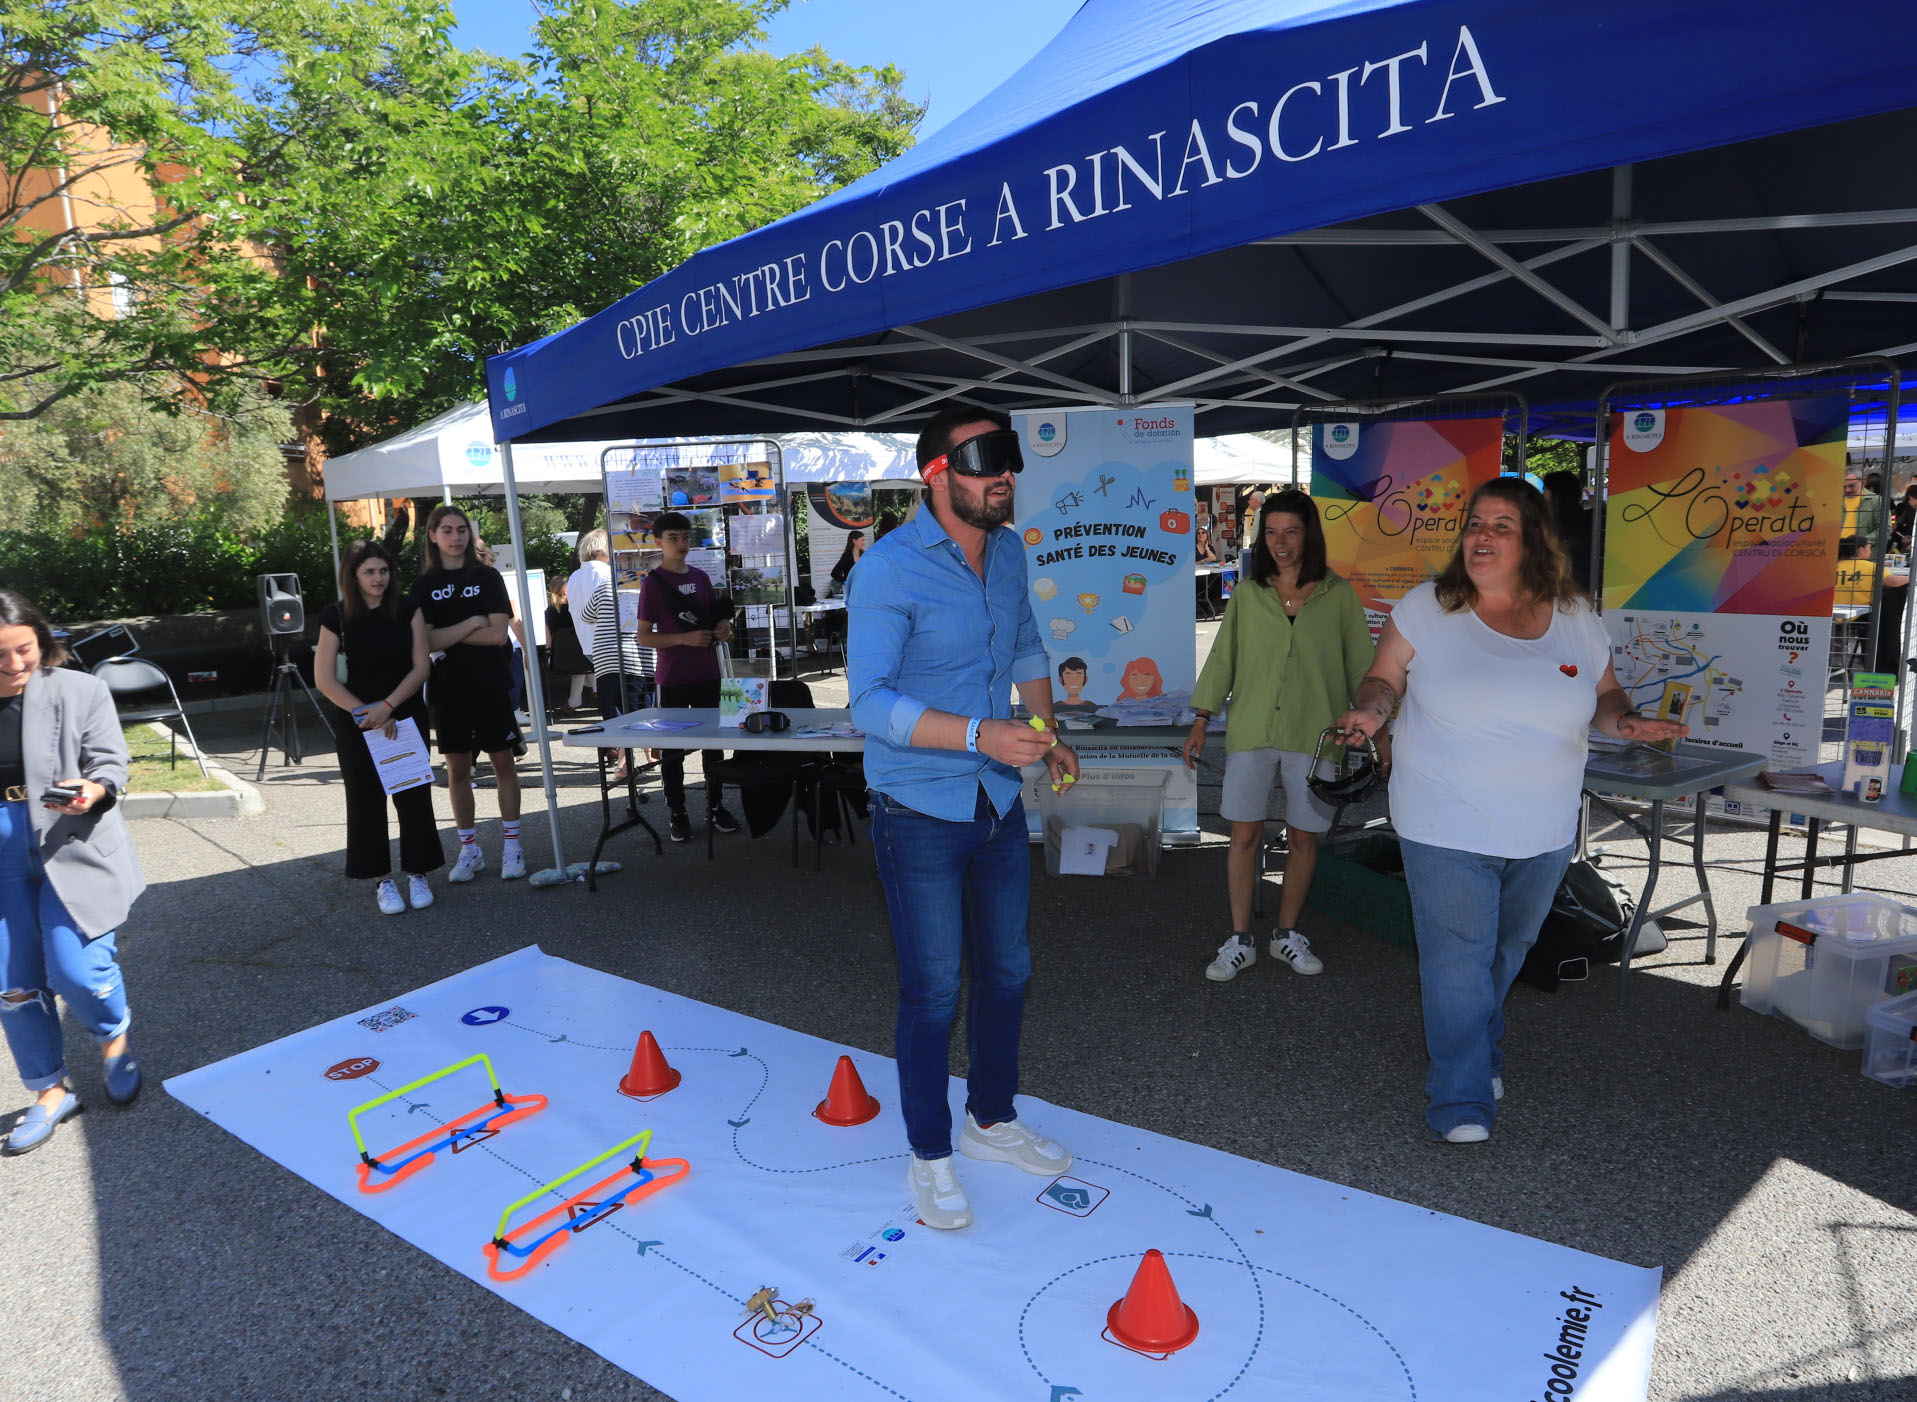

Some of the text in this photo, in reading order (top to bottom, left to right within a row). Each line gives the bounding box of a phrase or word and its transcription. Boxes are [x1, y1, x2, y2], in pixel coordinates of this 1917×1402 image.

[616, 24, 1506, 360] CPIE CENTRE CORSE A RINASCITA
[1134, 416, 1175, 430] Fonds
[1134, 428, 1181, 438] de dotation
[1054, 521, 1147, 541] PRÉVENTION
[1036, 543, 1177, 567] SANTÉ DES JEUNES
[431, 584, 480, 600] adias
[679, 583, 697, 595] NIKE
[1780, 620, 1808, 635] Où
[1779, 636, 1810, 644] nous
[1853, 688, 1891, 697] CANNABIS
[1712, 739, 1744, 749] d'accueil
[1118, 752, 1149, 760] Mutuelle
[1081, 772, 1135, 780] Plus d'infos
[328, 1059, 373, 1079] STOP
[1530, 1285, 1603, 1402] coolemie.fr
